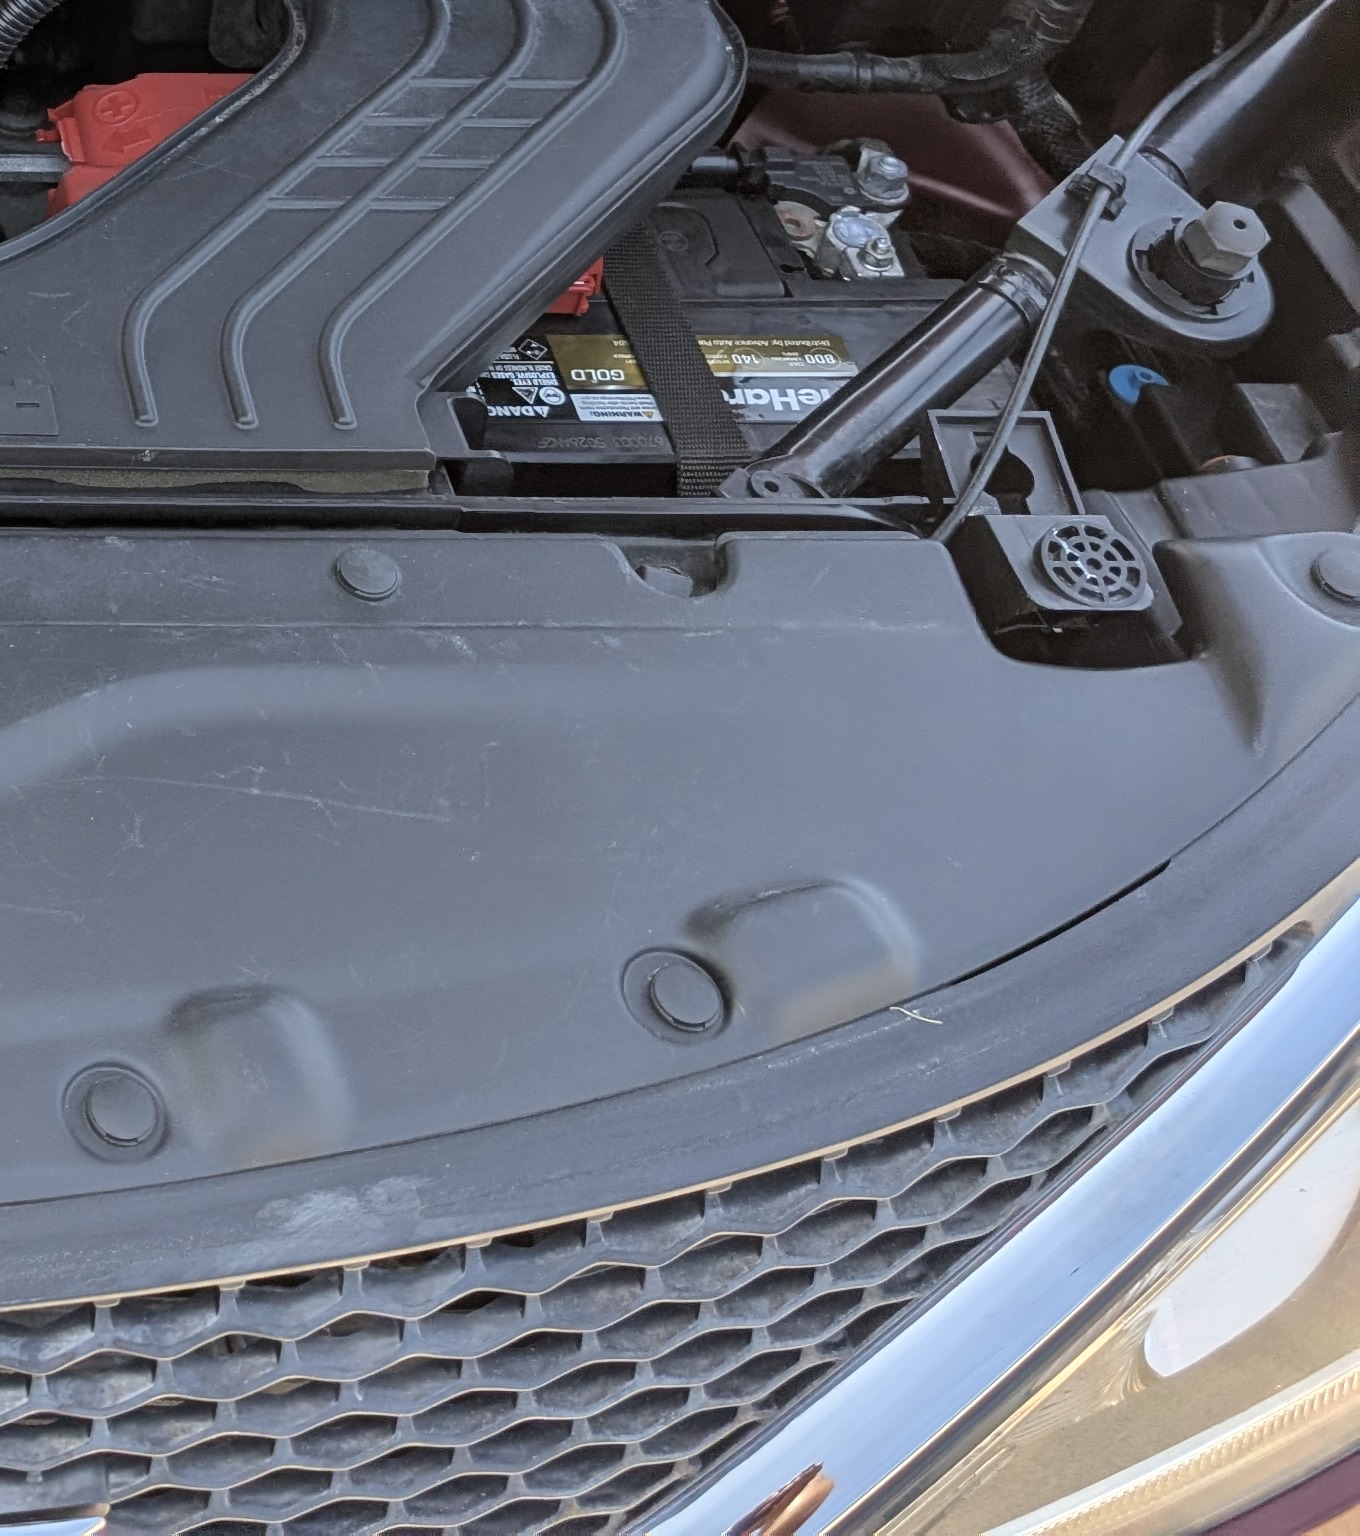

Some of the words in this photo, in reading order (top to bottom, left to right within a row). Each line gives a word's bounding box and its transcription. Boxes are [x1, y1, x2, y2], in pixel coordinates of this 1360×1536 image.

[731, 353, 760, 364] 140
[803, 353, 836, 364] 800
[570, 368, 625, 381] GOLD
[589, 410, 644, 418] WARNING:
